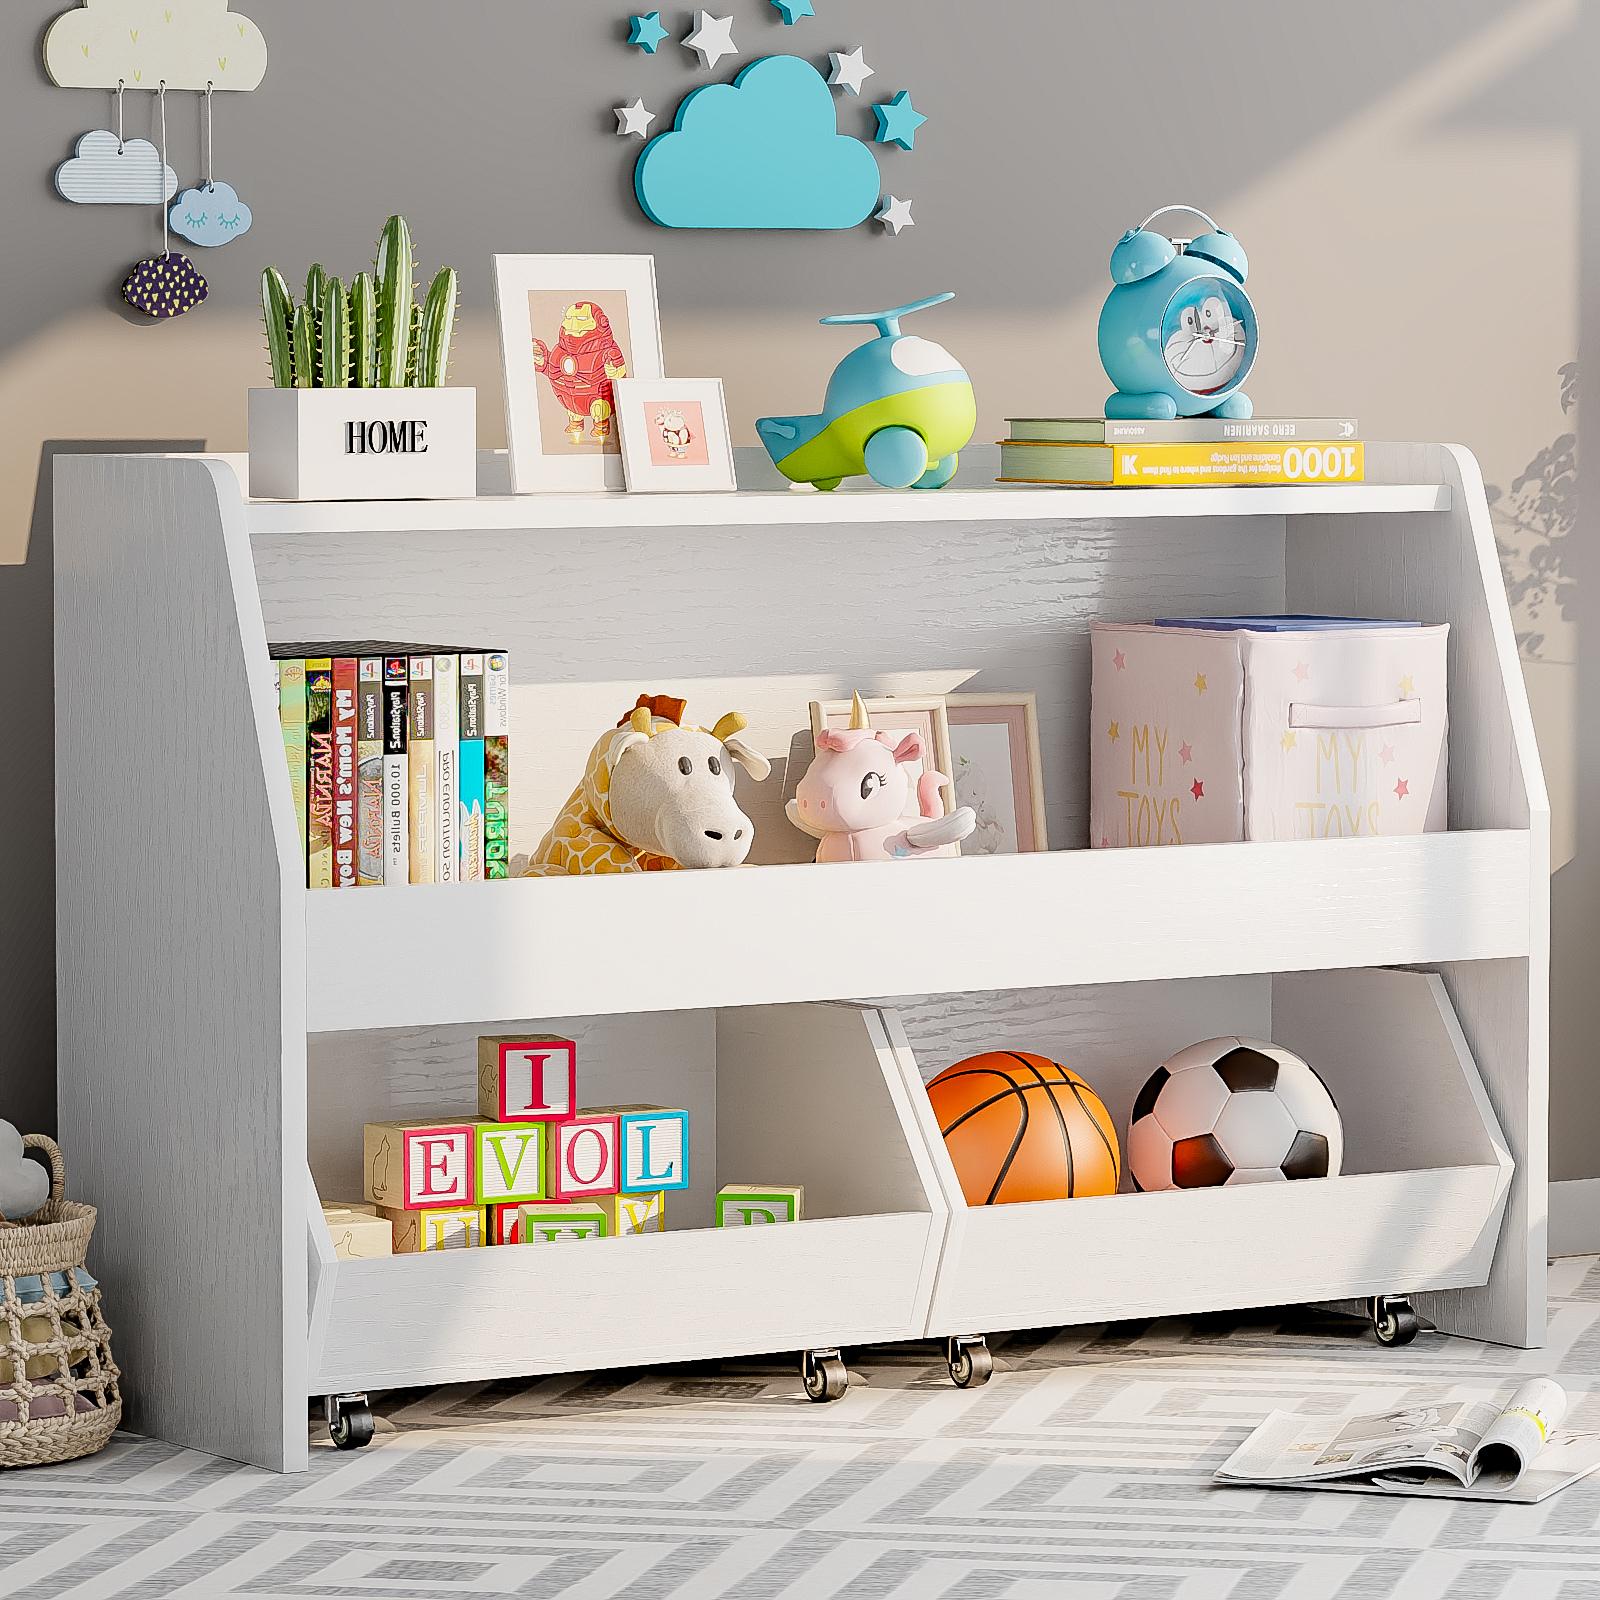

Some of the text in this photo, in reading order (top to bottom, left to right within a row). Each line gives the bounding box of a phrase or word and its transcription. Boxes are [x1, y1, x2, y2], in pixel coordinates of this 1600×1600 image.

[344, 420, 428, 454] HOME
[1223, 424, 1296, 437] EERO SAARINEN
[1283, 446, 1356, 479] 1000
[1131, 723, 1169, 787] MY
[1315, 732, 1367, 794] MY
[1117, 790, 1184, 847] TOYS
[523, 1054, 551, 1109] I
